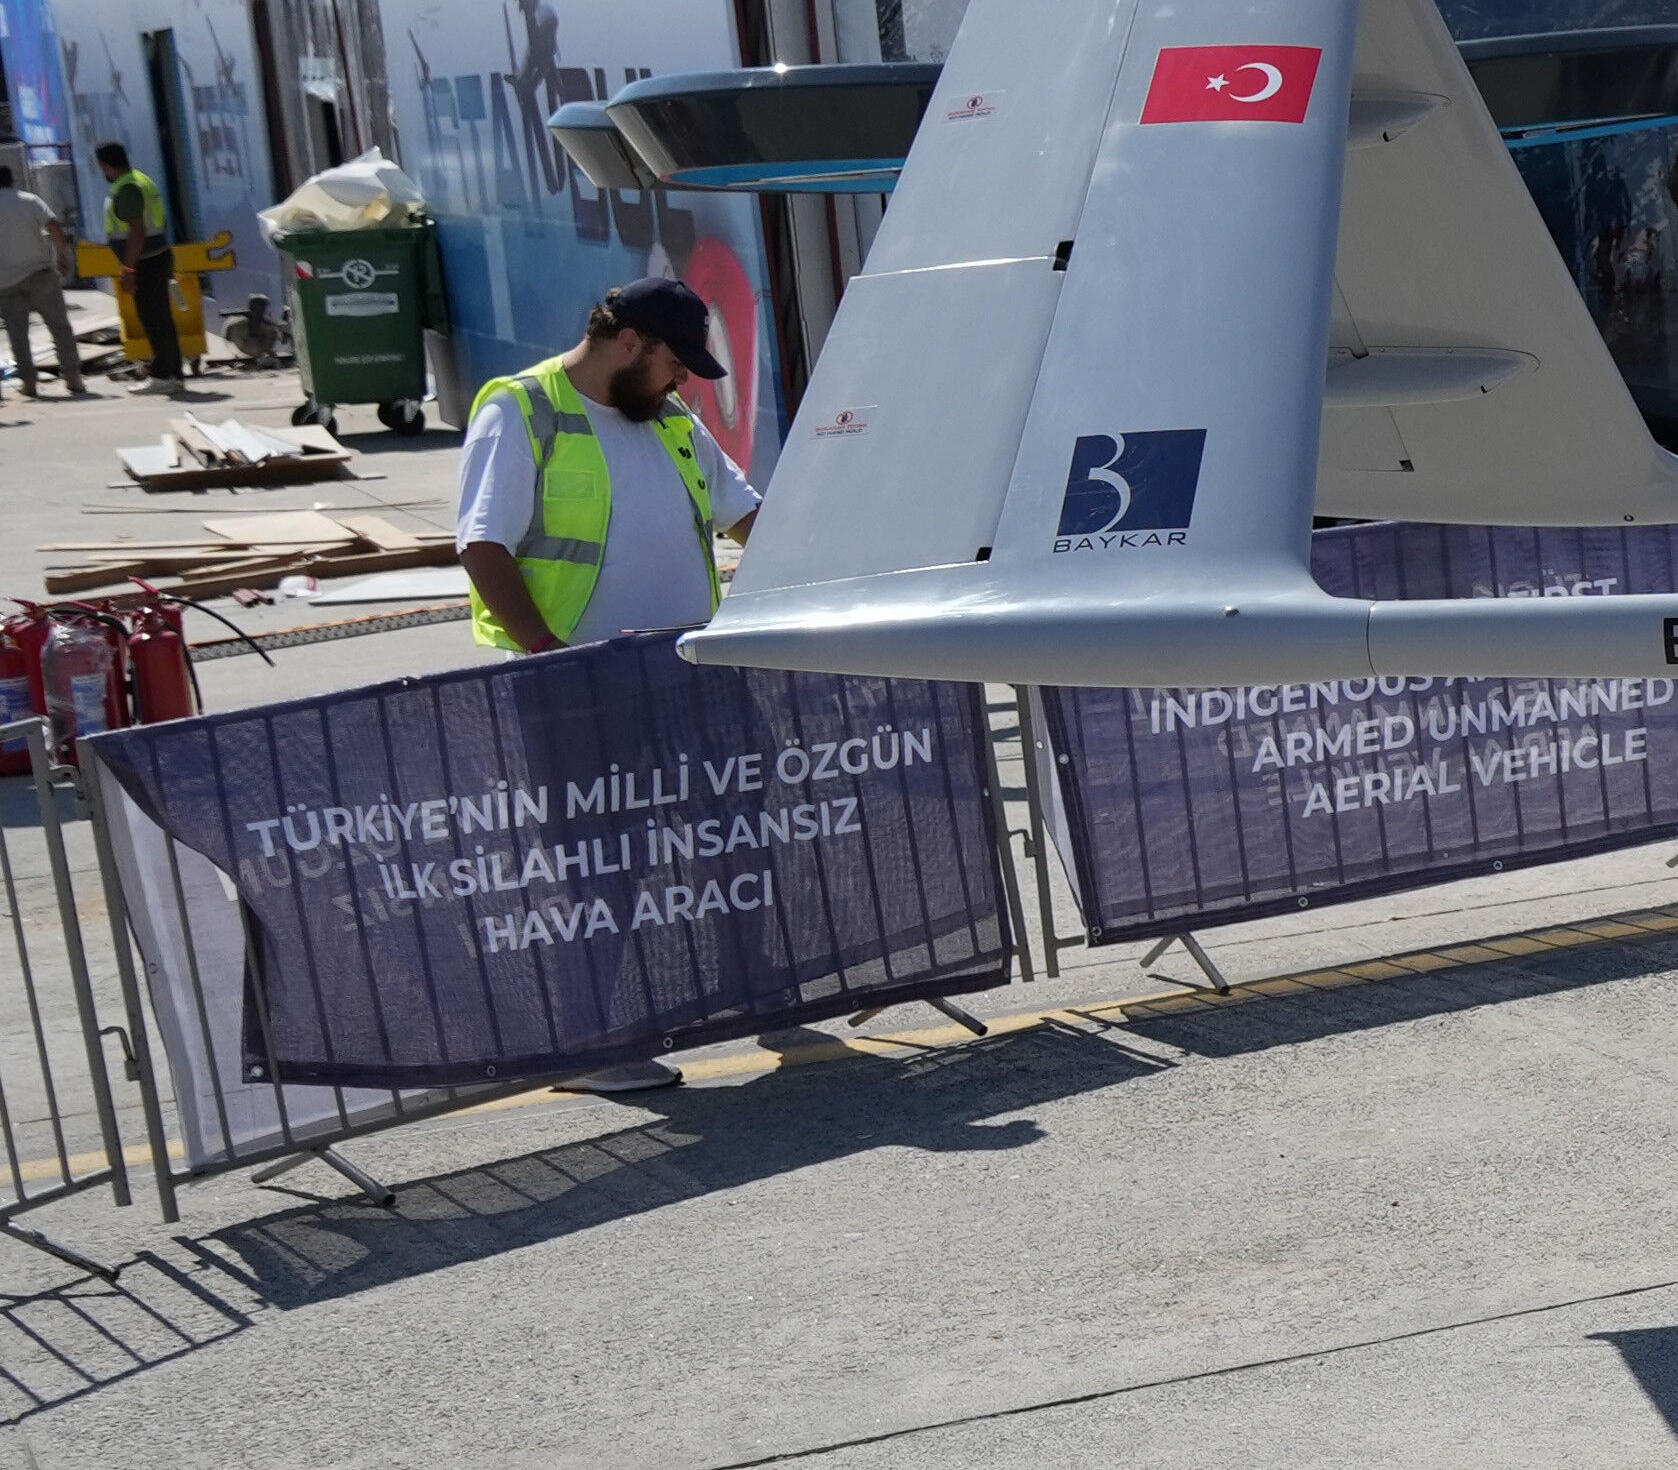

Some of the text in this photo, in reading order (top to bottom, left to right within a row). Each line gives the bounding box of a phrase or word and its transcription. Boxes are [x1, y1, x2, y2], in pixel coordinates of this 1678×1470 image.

[1052, 530, 1187, 554] BAYKAR
[1252, 678, 1674, 773] ARMED UNMANNED
[247, 724, 933, 857] TÜRKİYE'NİN MİLLİ VE ÖZGÜN
[1302, 764, 1460, 819] AERIAL
[1471, 728, 1648, 787] VEHICLE
[379, 853, 445, 901] İLK
[451, 829, 631, 898] SİLAHLI
[647, 796, 861, 866] İNSANSIZ
[485, 869, 774, 955] HAVA ARACI
